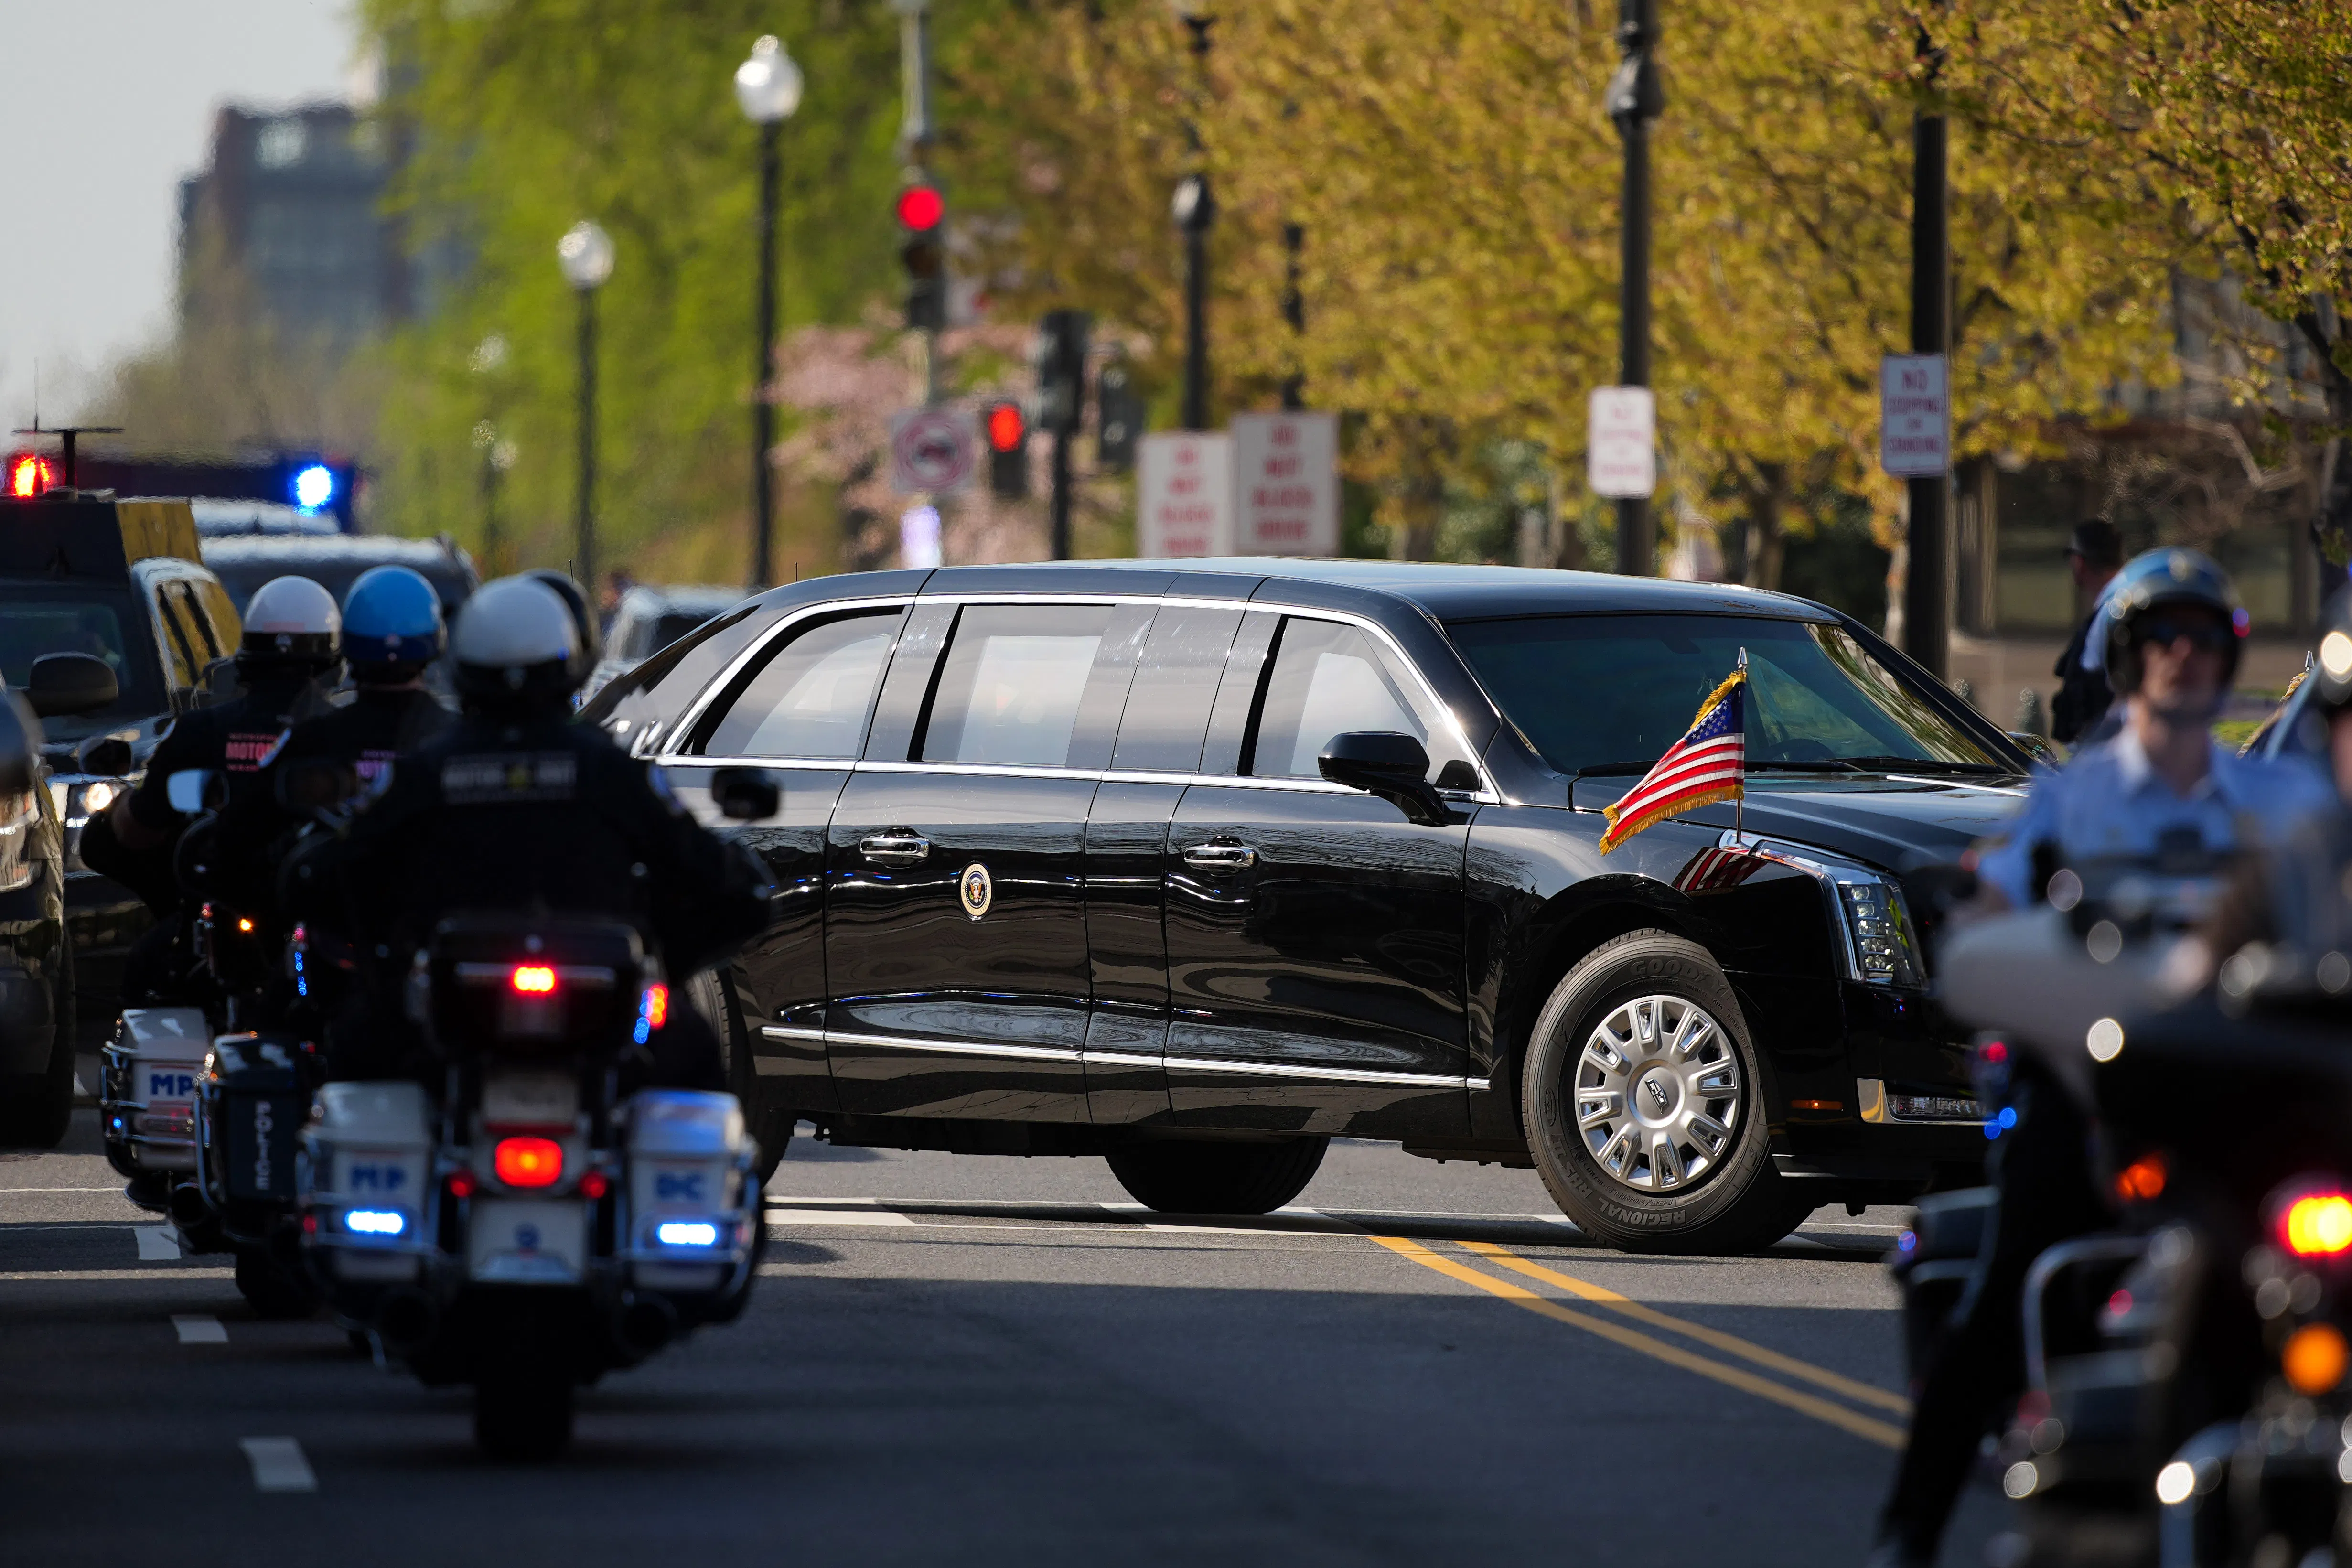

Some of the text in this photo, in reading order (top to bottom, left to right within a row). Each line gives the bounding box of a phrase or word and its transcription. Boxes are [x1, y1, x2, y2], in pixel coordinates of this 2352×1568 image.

[962, 866, 977, 889] PRESIDENT
[255, 1100, 273, 1191] POLICE
[1561, 1161, 1593, 1199] RHS
[1599, 1196, 1686, 1226] REGIONAL
